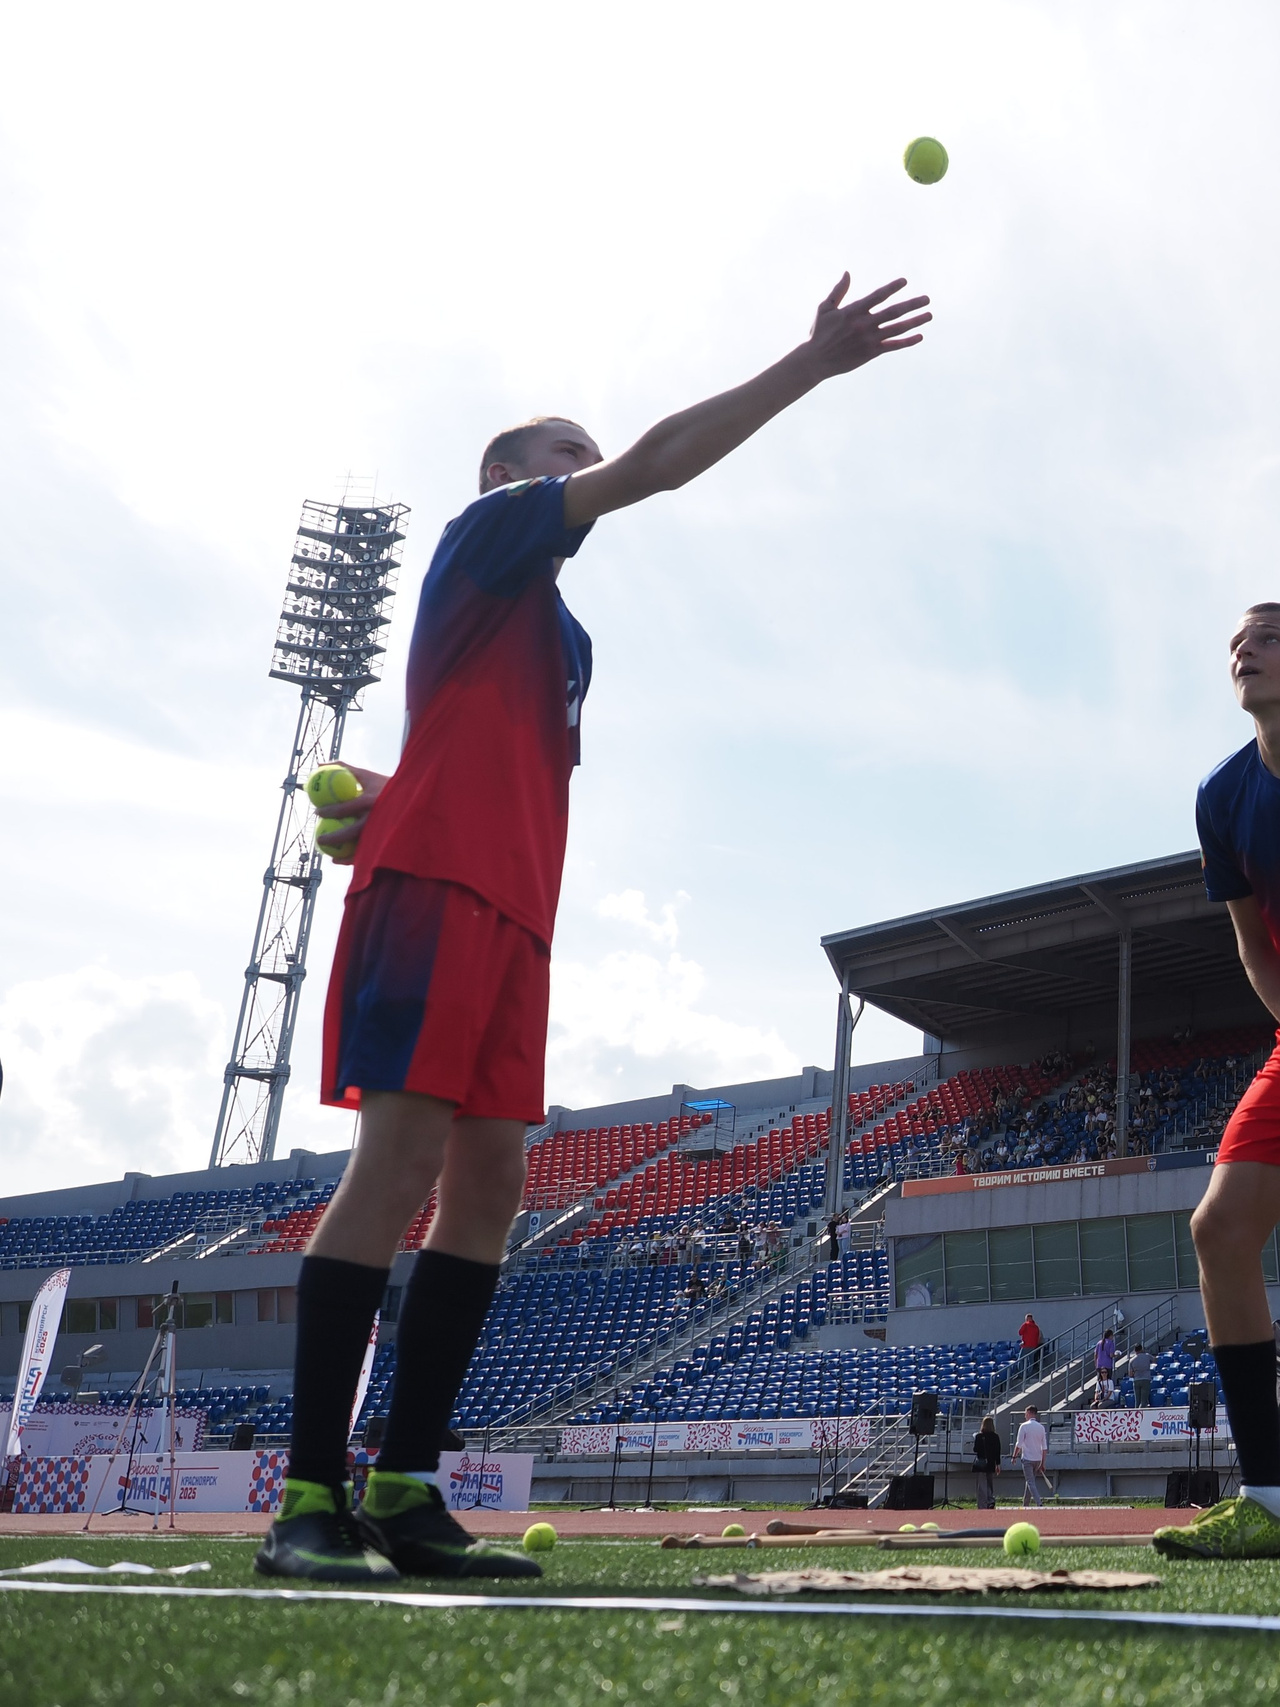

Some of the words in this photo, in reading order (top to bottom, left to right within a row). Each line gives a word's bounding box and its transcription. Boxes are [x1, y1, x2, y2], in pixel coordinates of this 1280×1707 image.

[973, 1174, 1012, 1187] ТВОРИМ
[1013, 1169, 1061, 1184] ИСТОРИЮ
[1063, 1165, 1105, 1178] ВМЕСТЕ
[745, 1433, 773, 1445] ЛАПТА
[180, 1476, 218, 1486] КРАСНОЯРСК
[179, 1487, 197, 1500] 2025
